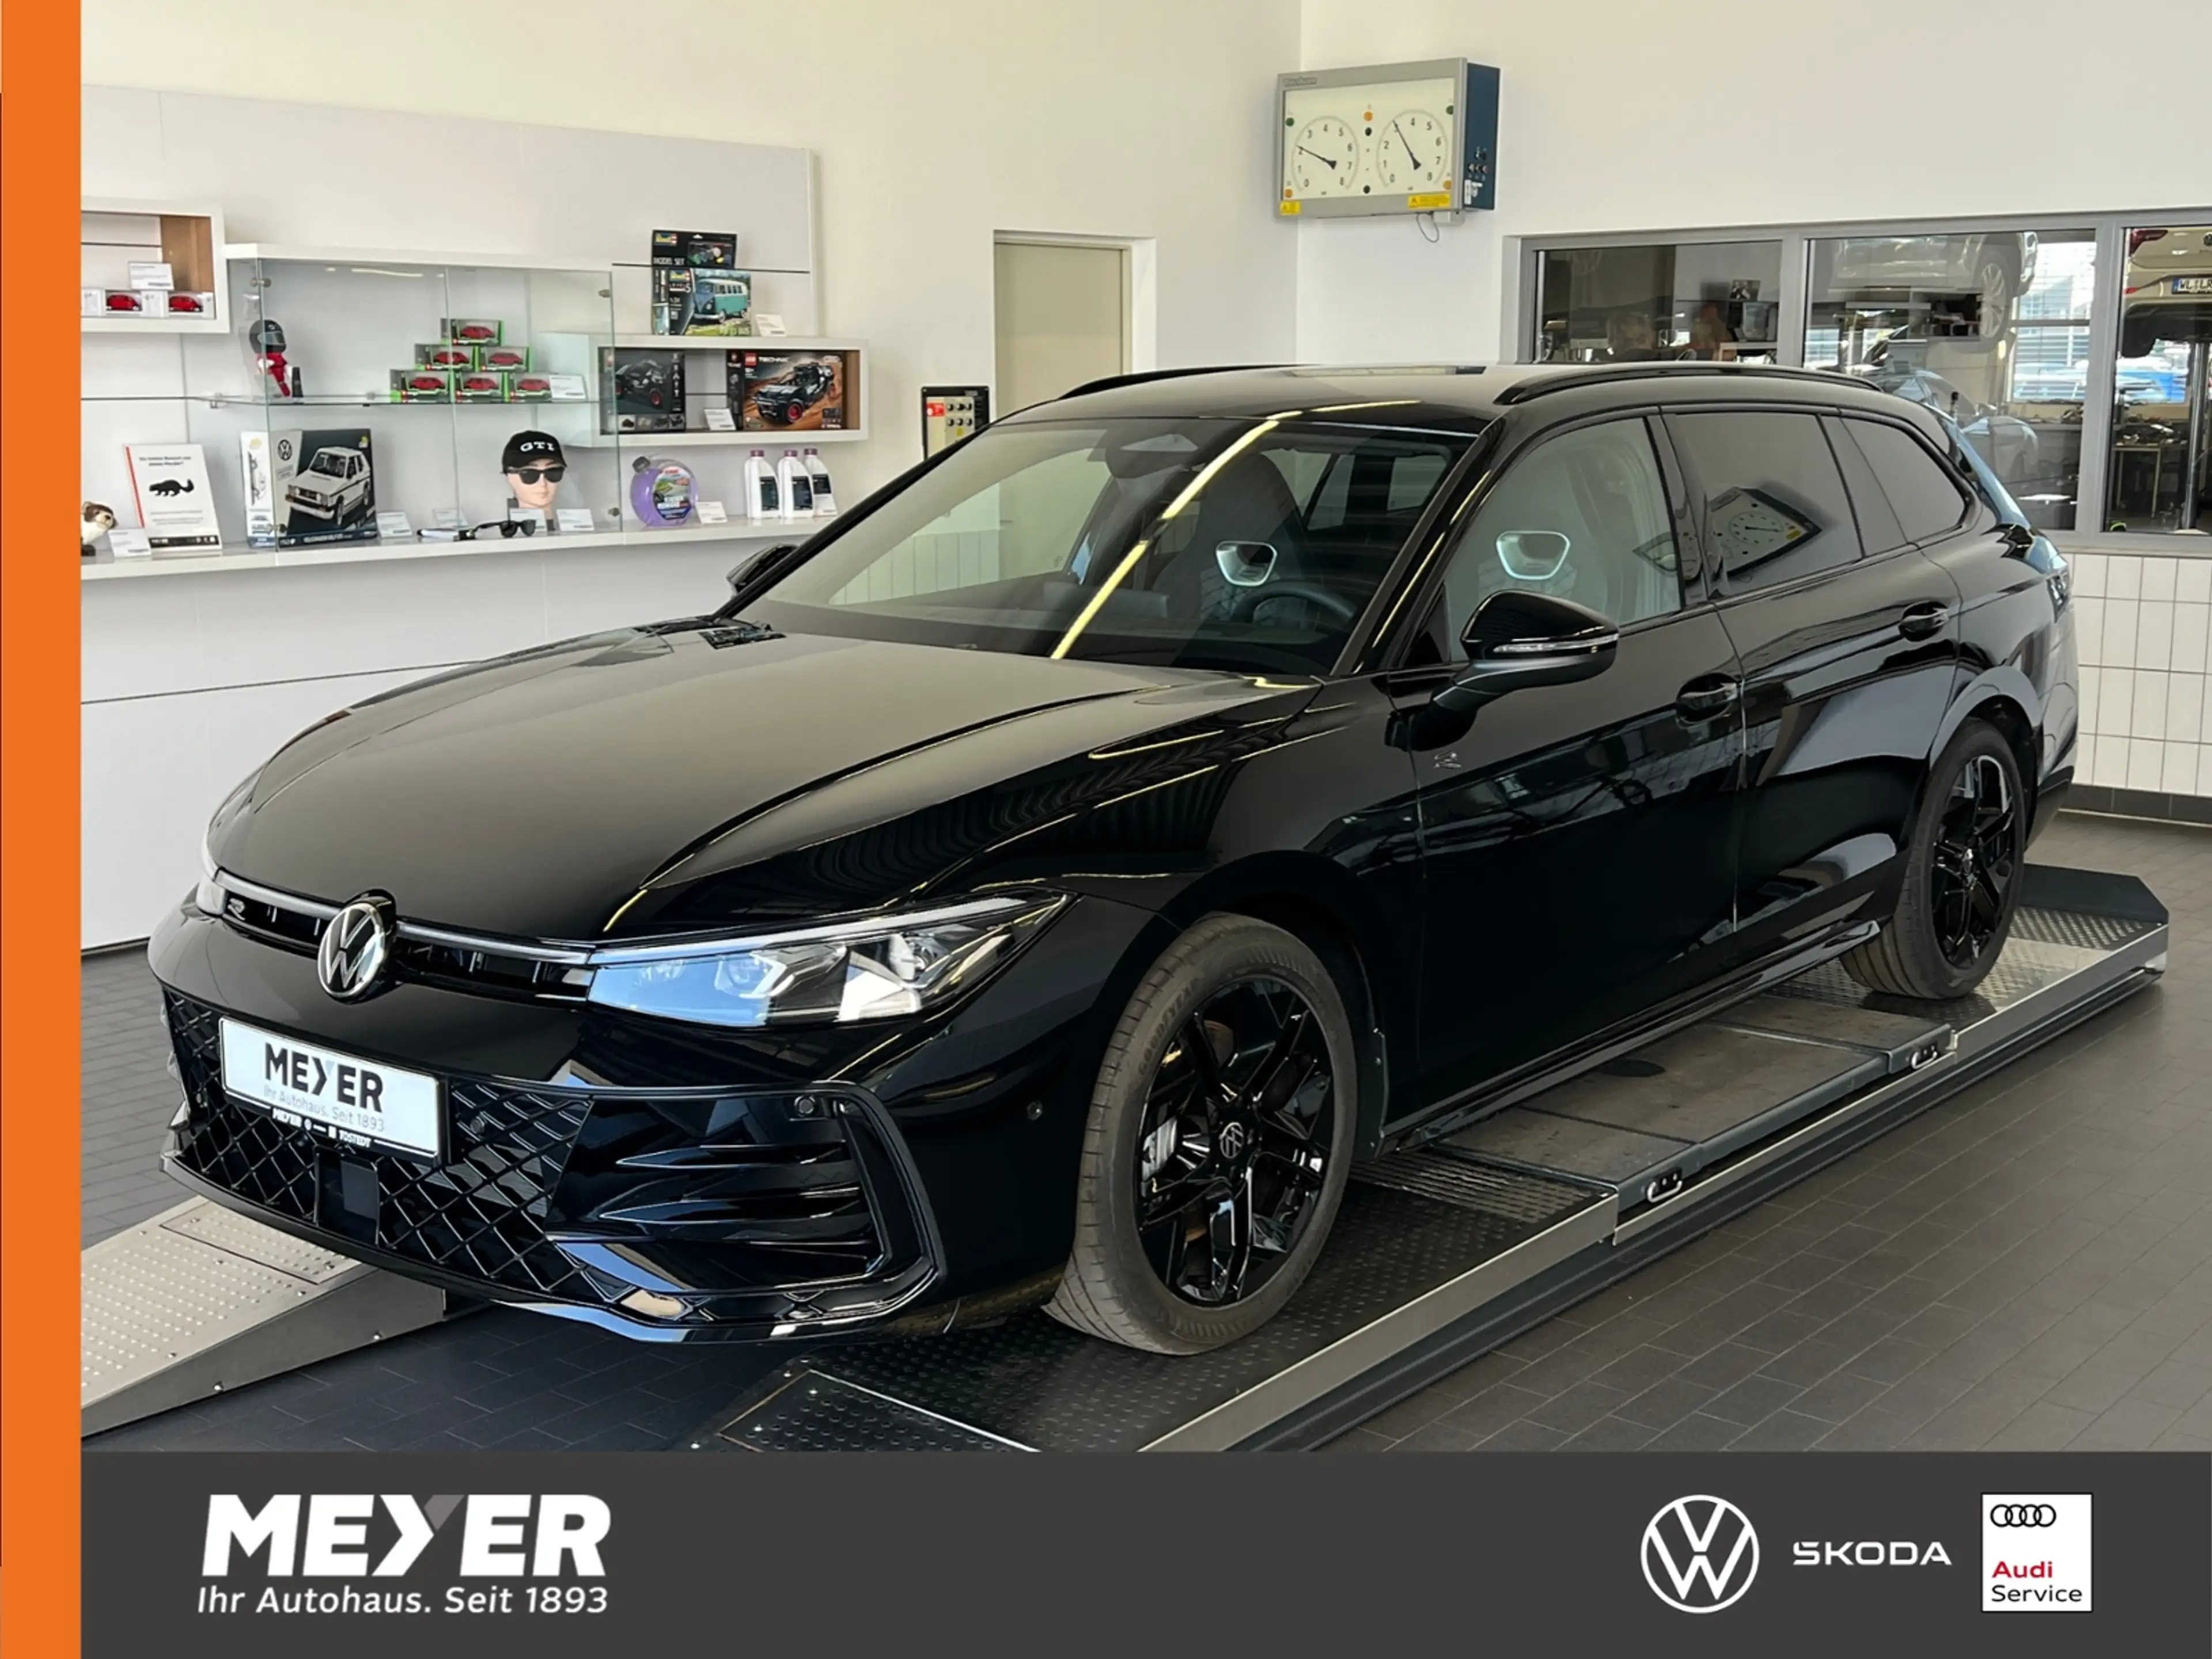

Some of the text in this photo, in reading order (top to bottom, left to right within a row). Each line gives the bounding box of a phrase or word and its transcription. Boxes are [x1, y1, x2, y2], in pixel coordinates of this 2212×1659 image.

[1410, 118, 1415, 126] 4
[1426, 122, 1432, 131] 5
[1307, 130, 1312, 139] 3
[1338, 127, 1344, 137] 5
[1384, 141, 1389, 150] 2
[1435, 137, 1441, 146] 6
[1347, 142, 1353, 151] 6
[1384, 160, 1387, 168] 1
[1435, 156, 1441, 165] 7
[1298, 165, 1301, 173] 1
[1348, 161, 1353, 170] 7
[1389, 173, 1395, 183] 0
[1304, 179, 1309, 187] 0
[520, 441, 556, 452] GTI
[265, 1042, 384, 1113] MEYER
[264, 1085, 277, 1100] Ihr
[279, 1089, 329, 1118] Autohaus.
[331, 1106, 354, 1124] Seit
[357, 1112, 385, 1133] 1893
